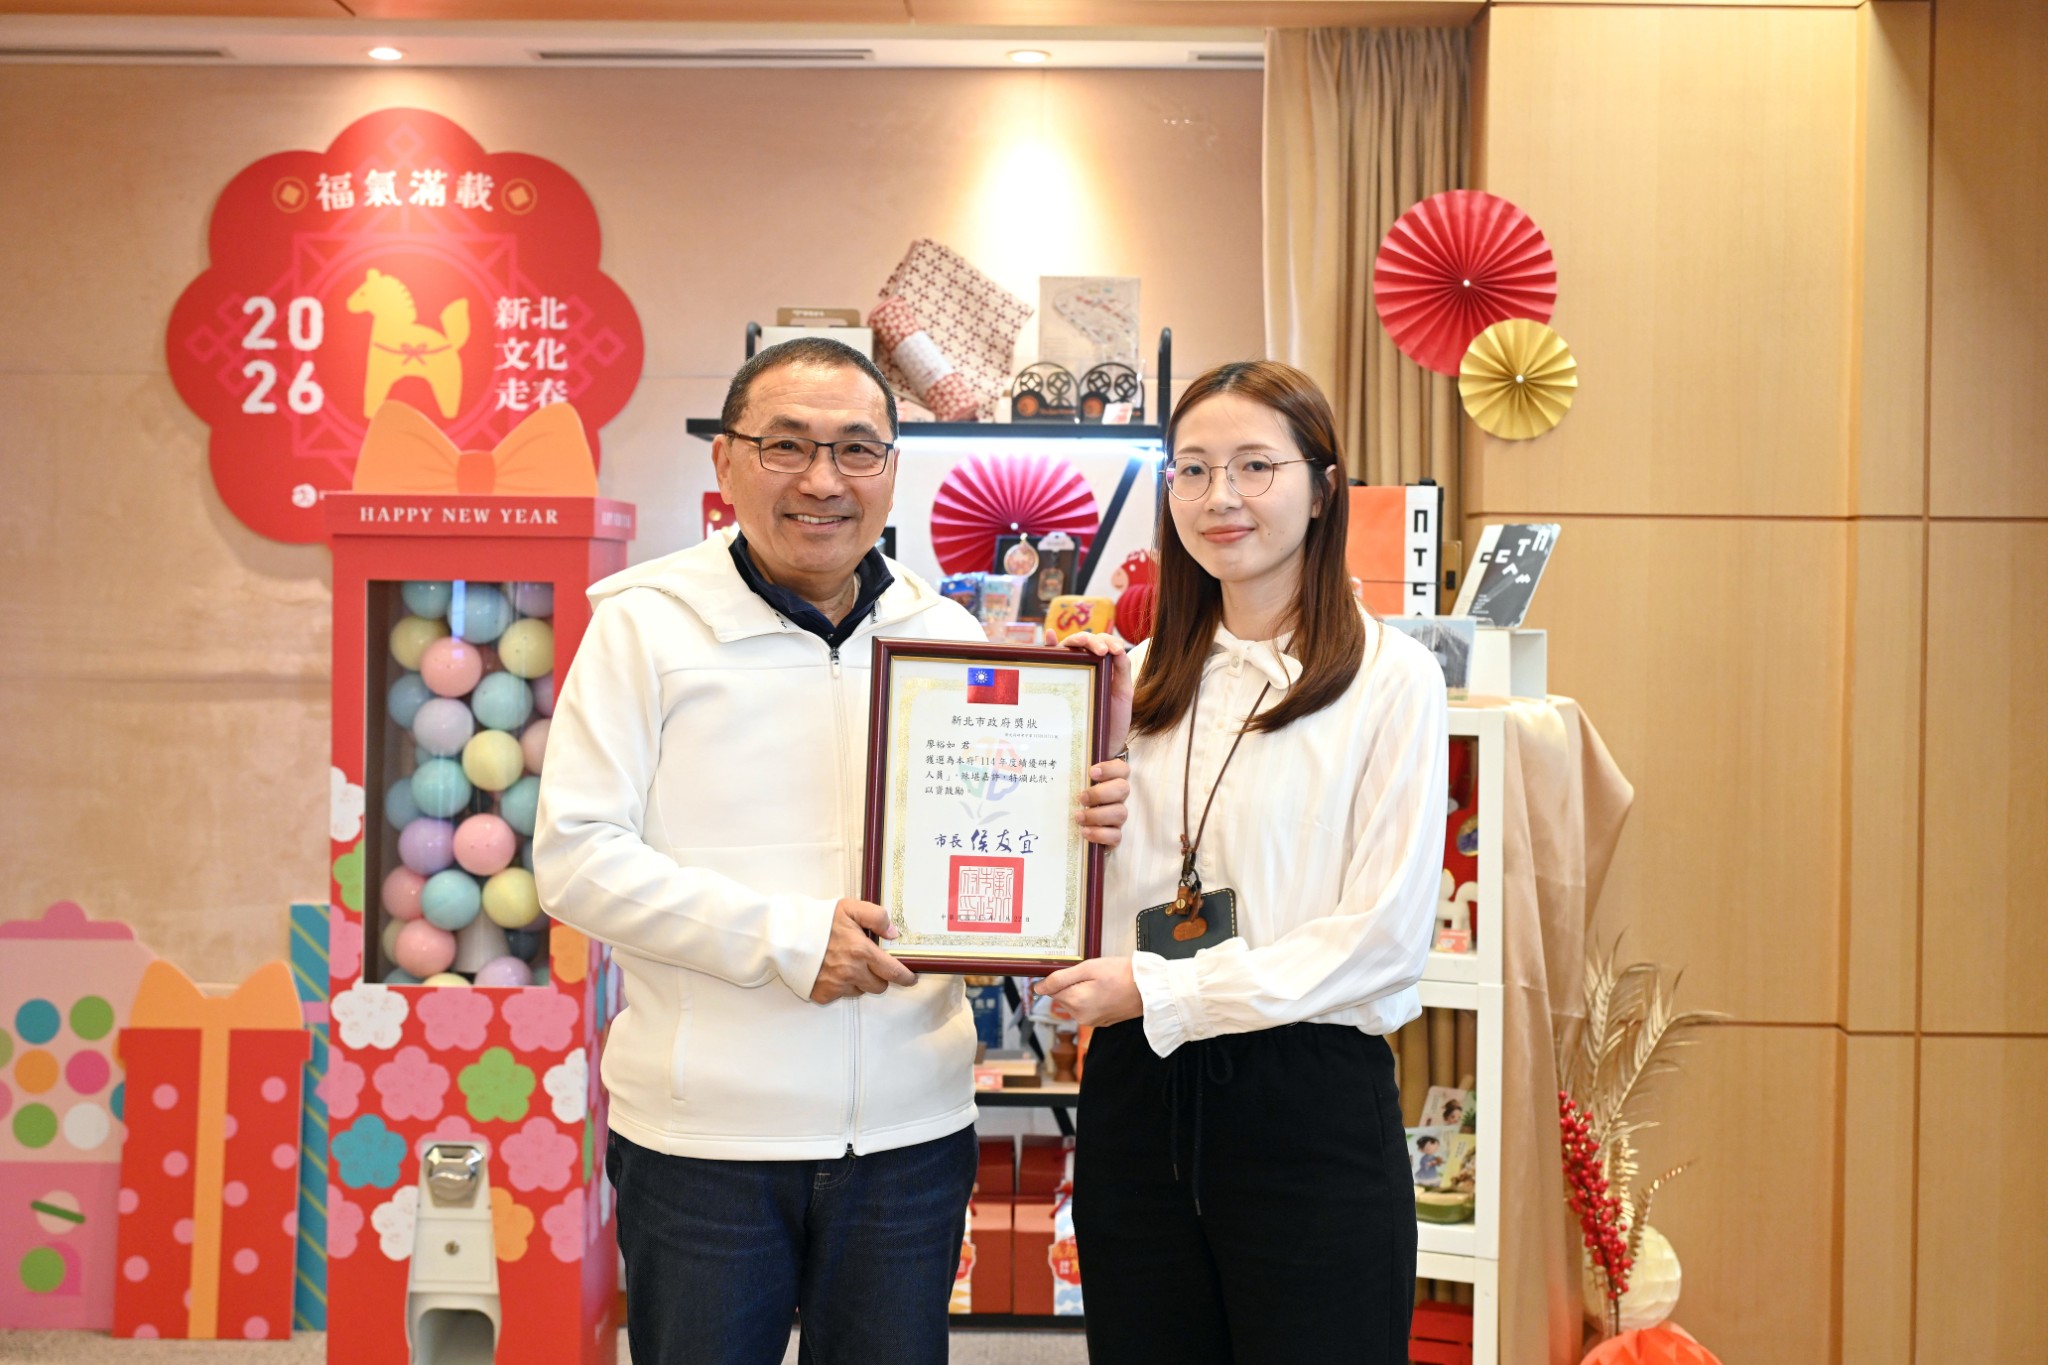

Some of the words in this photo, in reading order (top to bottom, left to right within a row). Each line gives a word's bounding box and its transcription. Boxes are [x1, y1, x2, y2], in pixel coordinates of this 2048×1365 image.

[315, 169, 495, 212] 福氣滿載
[241, 296, 324, 351] 20
[495, 296, 568, 330] 新北
[494, 338, 568, 371] 文化
[241, 360, 324, 414] 26
[360, 507, 433, 522] HAPPY
[442, 507, 490, 523] NEW
[501, 508, 559, 524] YEAR
[951, 715, 1038, 729] 新北市政府獎狀
[934, 833, 963, 848] 市長
[971, 829, 1039, 854] 侯友宜
